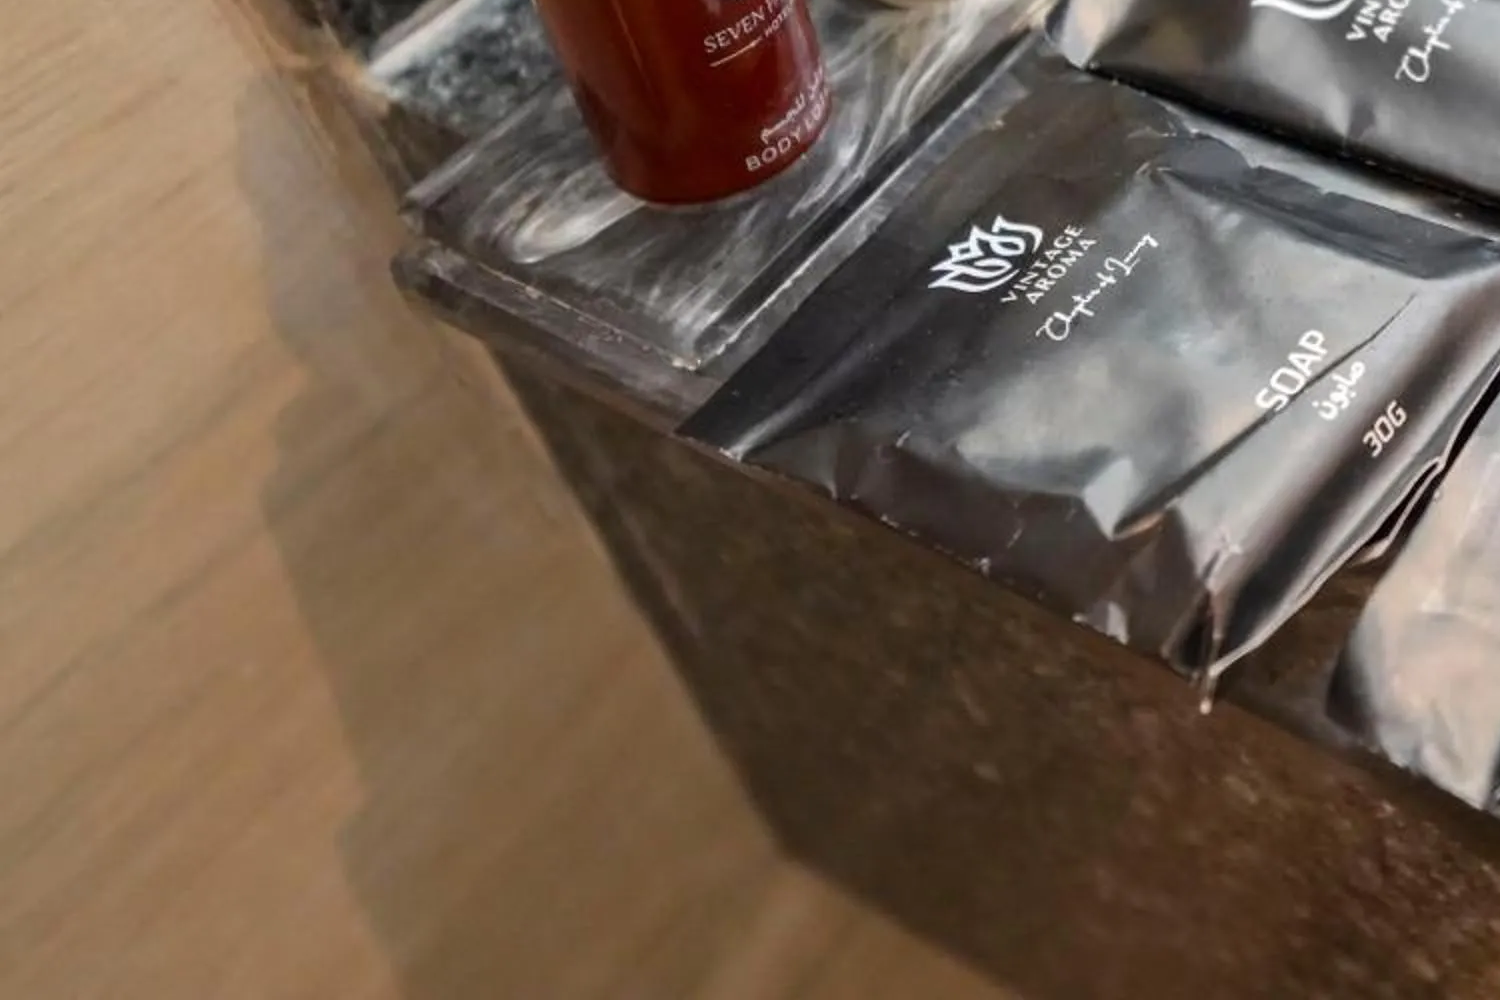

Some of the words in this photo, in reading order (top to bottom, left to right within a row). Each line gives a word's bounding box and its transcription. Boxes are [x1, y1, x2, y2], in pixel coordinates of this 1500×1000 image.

[703, 5, 766, 54] SEVEN
[745, 125, 801, 173] BODY
[1000, 224, 1085, 303] VINTAGE
[1026, 237, 1097, 305] AROMA
[1255, 329, 1329, 412] SOAP
[1311, 360, 1366, 420] صابون
[1362, 399, 1408, 458] 30G
